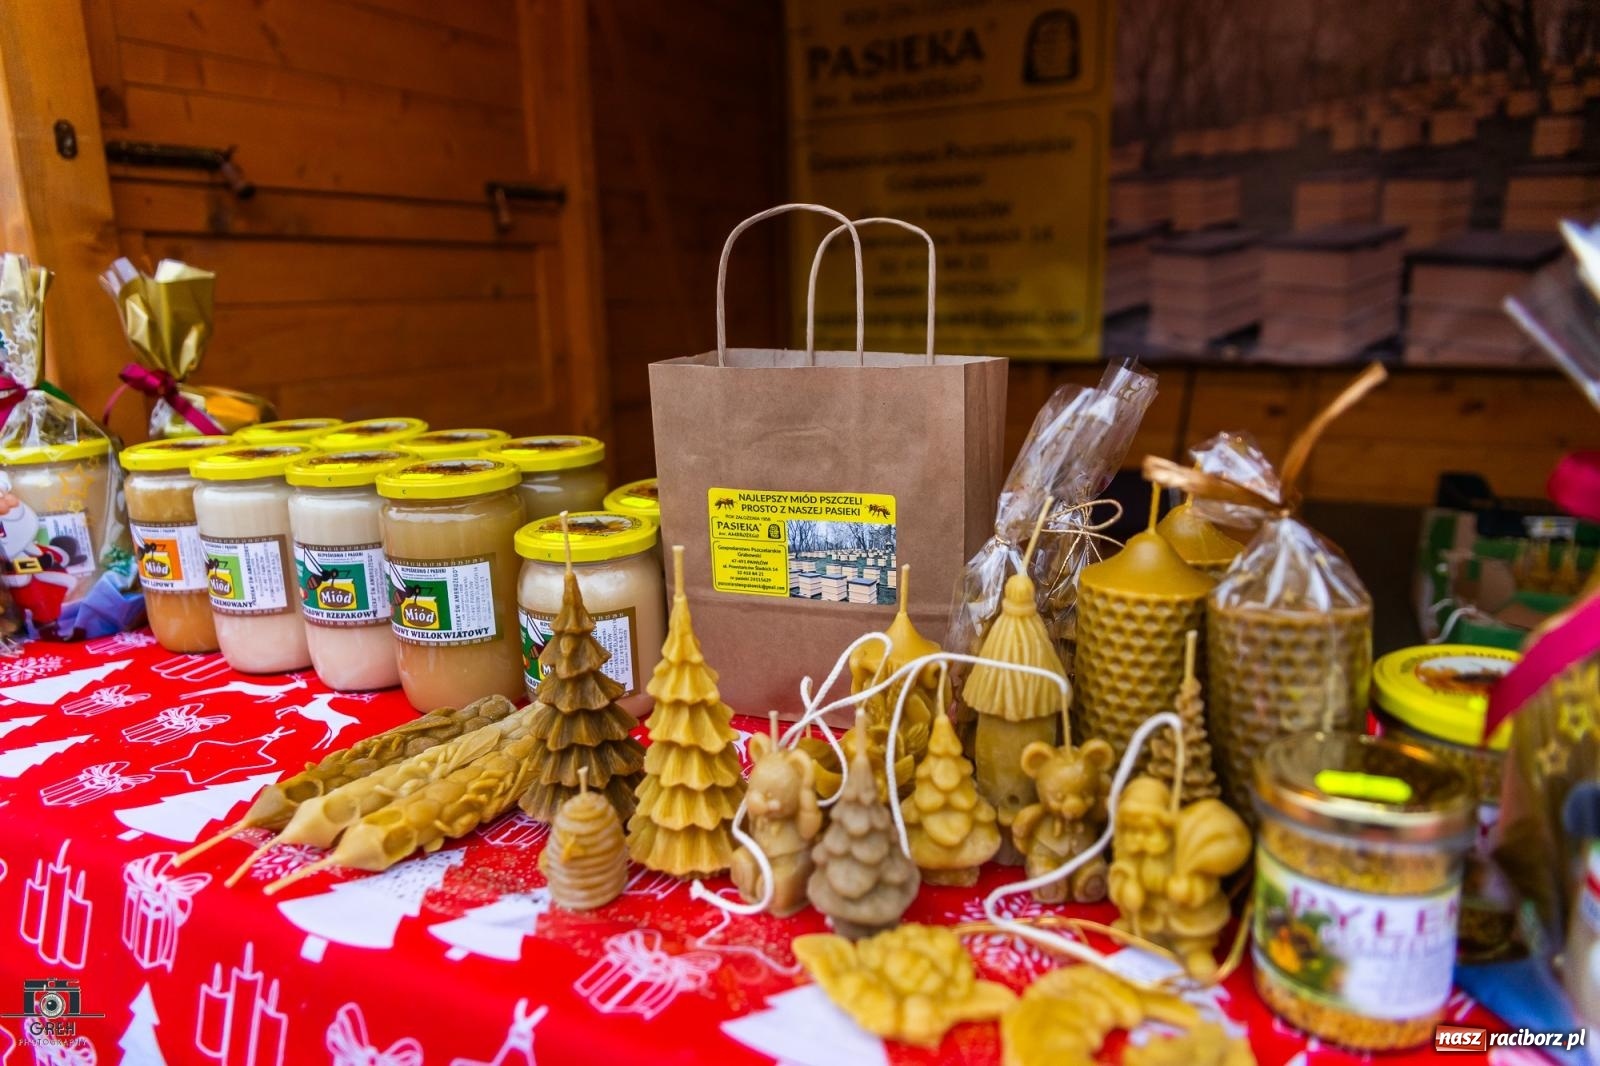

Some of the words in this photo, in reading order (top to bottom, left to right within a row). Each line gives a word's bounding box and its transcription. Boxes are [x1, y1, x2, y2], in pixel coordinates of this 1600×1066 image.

[806, 26, 985, 82] PASIEKA
[738, 493, 789, 503] NAJLEPSZY
[790, 493, 818, 504] MIÓD
[820, 496, 863, 505] PSZCZELI
[741, 504, 778, 514] PROSTO
[780, 504, 786, 513] Z
[788, 506, 823, 516] NASZEJ
[825, 507, 860, 516] PASIEKI
[717, 521, 760, 532] PASIEKA
[145, 560, 168, 574] Miód
[210, 578, 230, 592] Miód
[321, 591, 352, 604] Miód
[326, 610, 378, 619] RZEPAKOWY
[404, 608, 435, 623] Miód
[411, 627, 490, 640] WIELOKWIATOWY
